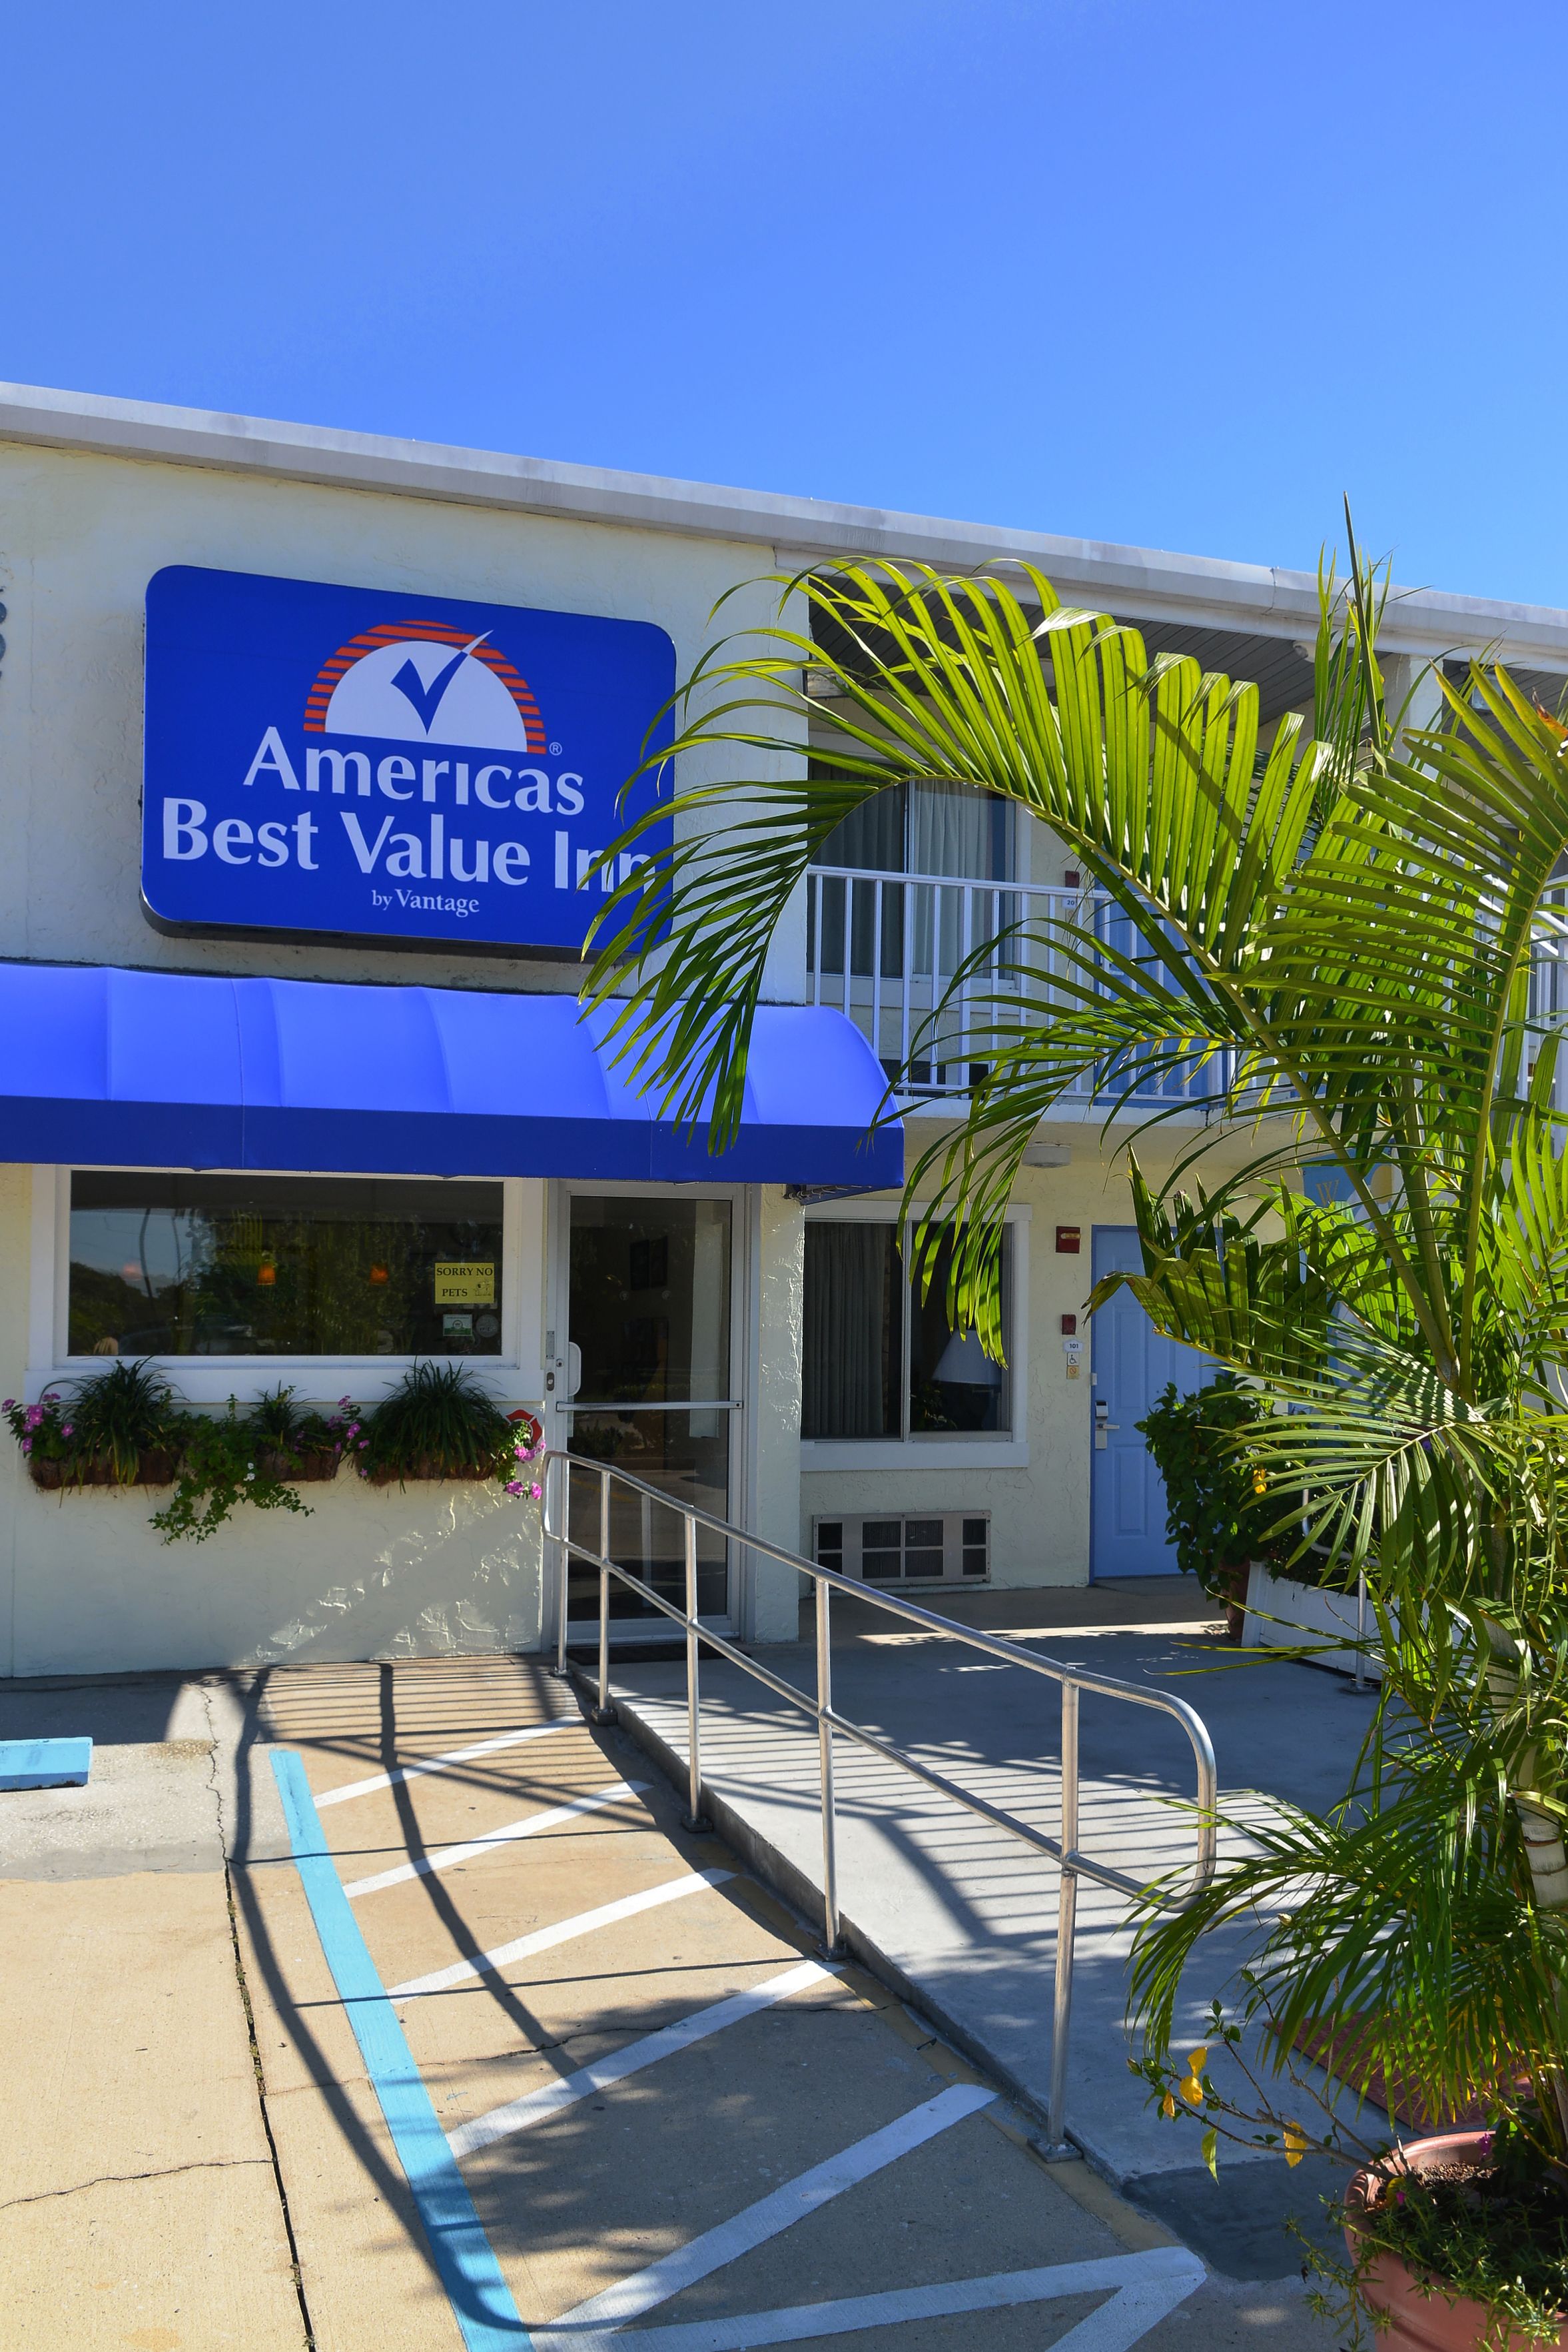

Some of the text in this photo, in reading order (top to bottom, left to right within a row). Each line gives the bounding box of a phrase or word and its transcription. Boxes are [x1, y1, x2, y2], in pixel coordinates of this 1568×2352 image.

[242, 726, 585, 816] Americas
[162, 797, 656, 894] Best Value Inn
[371, 889, 480, 918] by Vantage
[436, 1267, 493, 1276] SORRY NO
[442, 1288, 468, 1297] PETS
